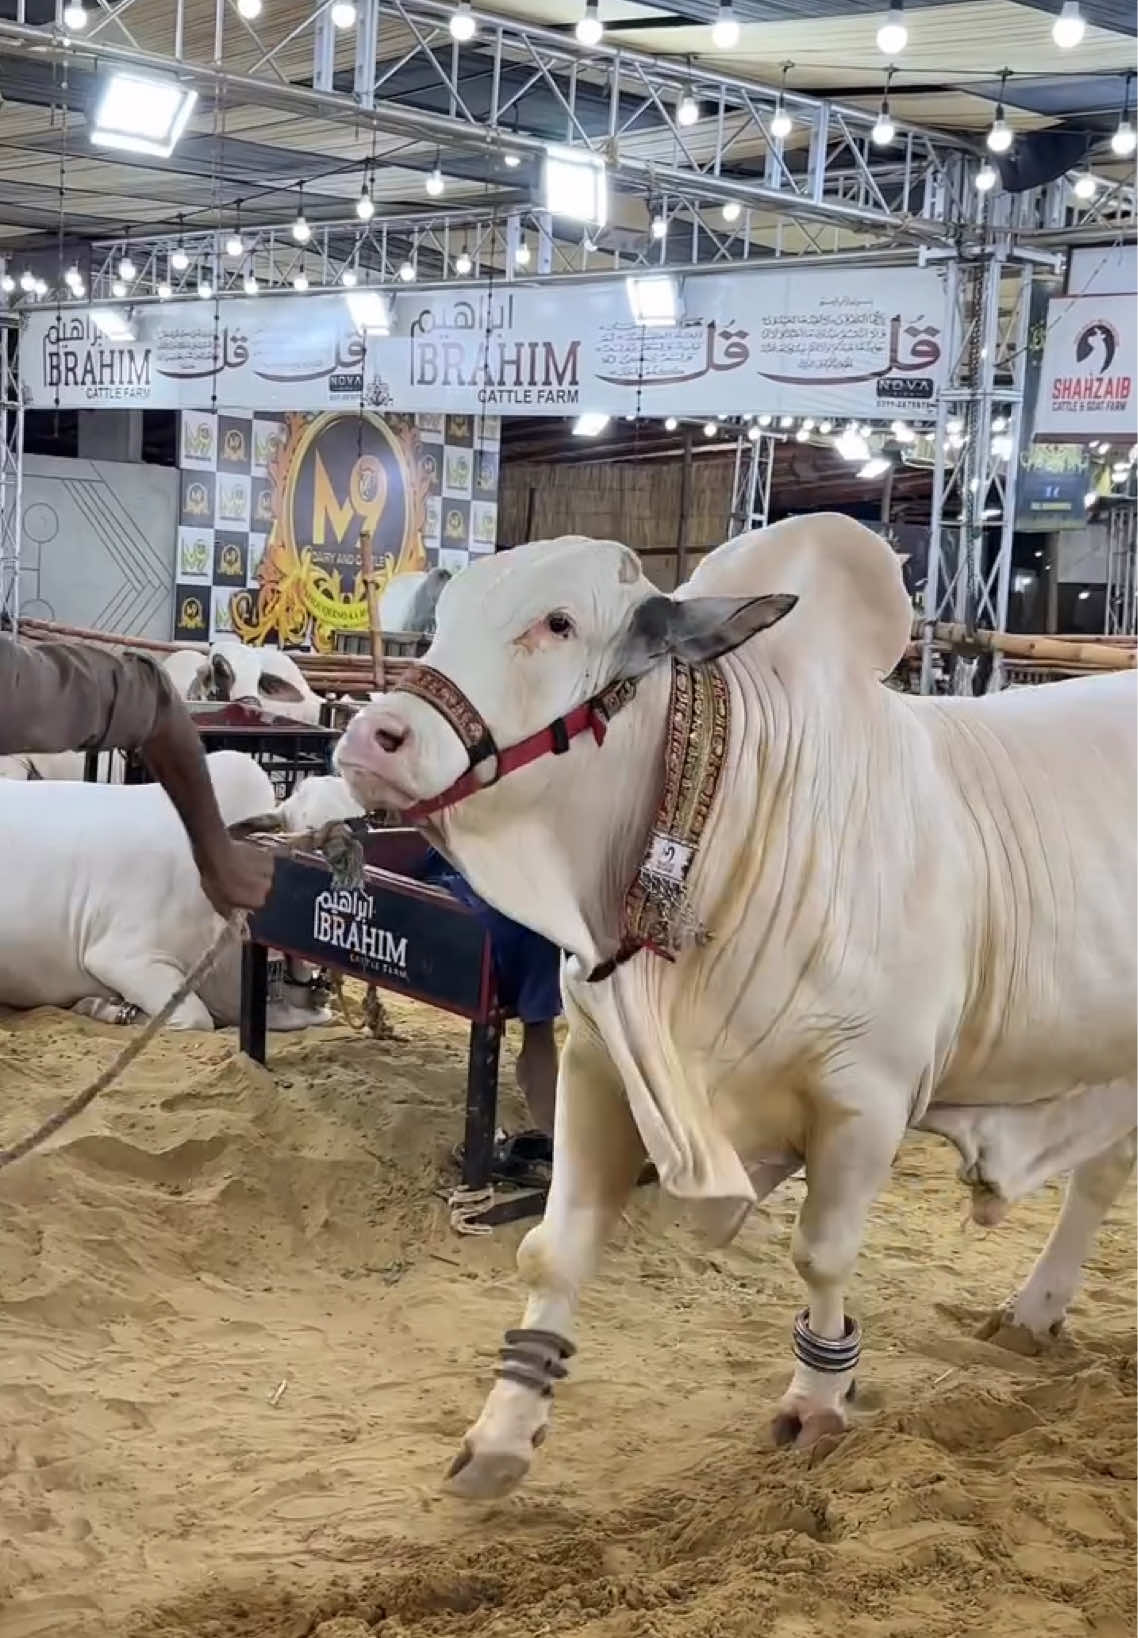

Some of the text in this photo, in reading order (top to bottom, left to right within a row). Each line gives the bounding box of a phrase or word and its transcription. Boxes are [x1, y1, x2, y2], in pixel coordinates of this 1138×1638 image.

[43, 346, 152, 387] IBRAHIM
[411, 340, 581, 386] IBRAHIM
[477, 389, 580, 404] CATTLE FARM
[1052, 377, 1131, 399] SHAHZAIB
[313, 447, 388, 545] M9
[314, 896, 408, 968] IBRAHIM
